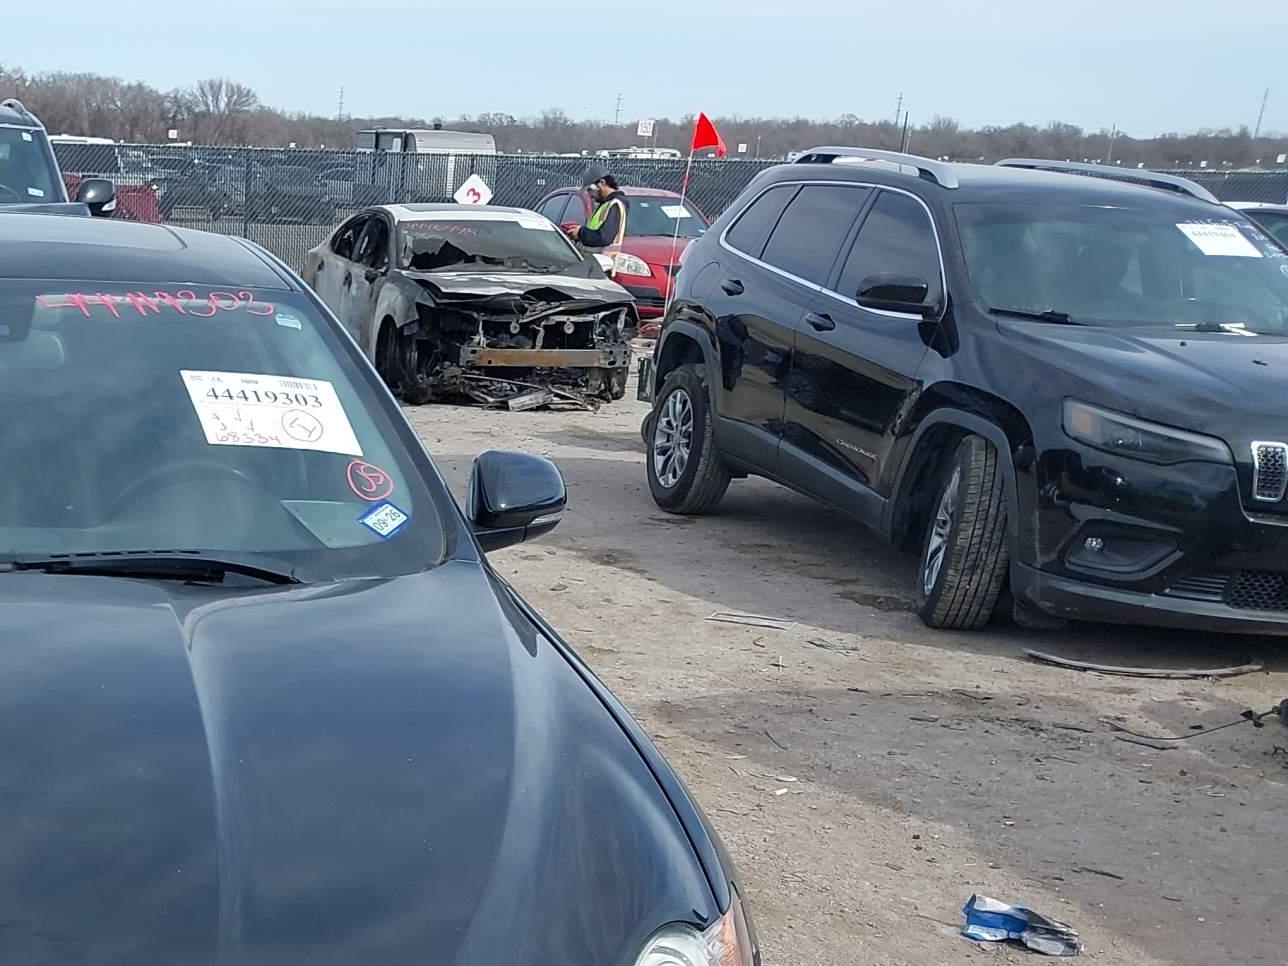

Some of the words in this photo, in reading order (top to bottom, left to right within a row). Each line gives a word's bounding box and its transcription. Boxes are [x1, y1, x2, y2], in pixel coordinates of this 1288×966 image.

[466, 187, 481, 204] 3
[206, 387, 323, 409] 44419303
[215, 430, 282, 445] 68334
[372, 518, 389, 531] 09
[385, 509, 401, 521] 26
